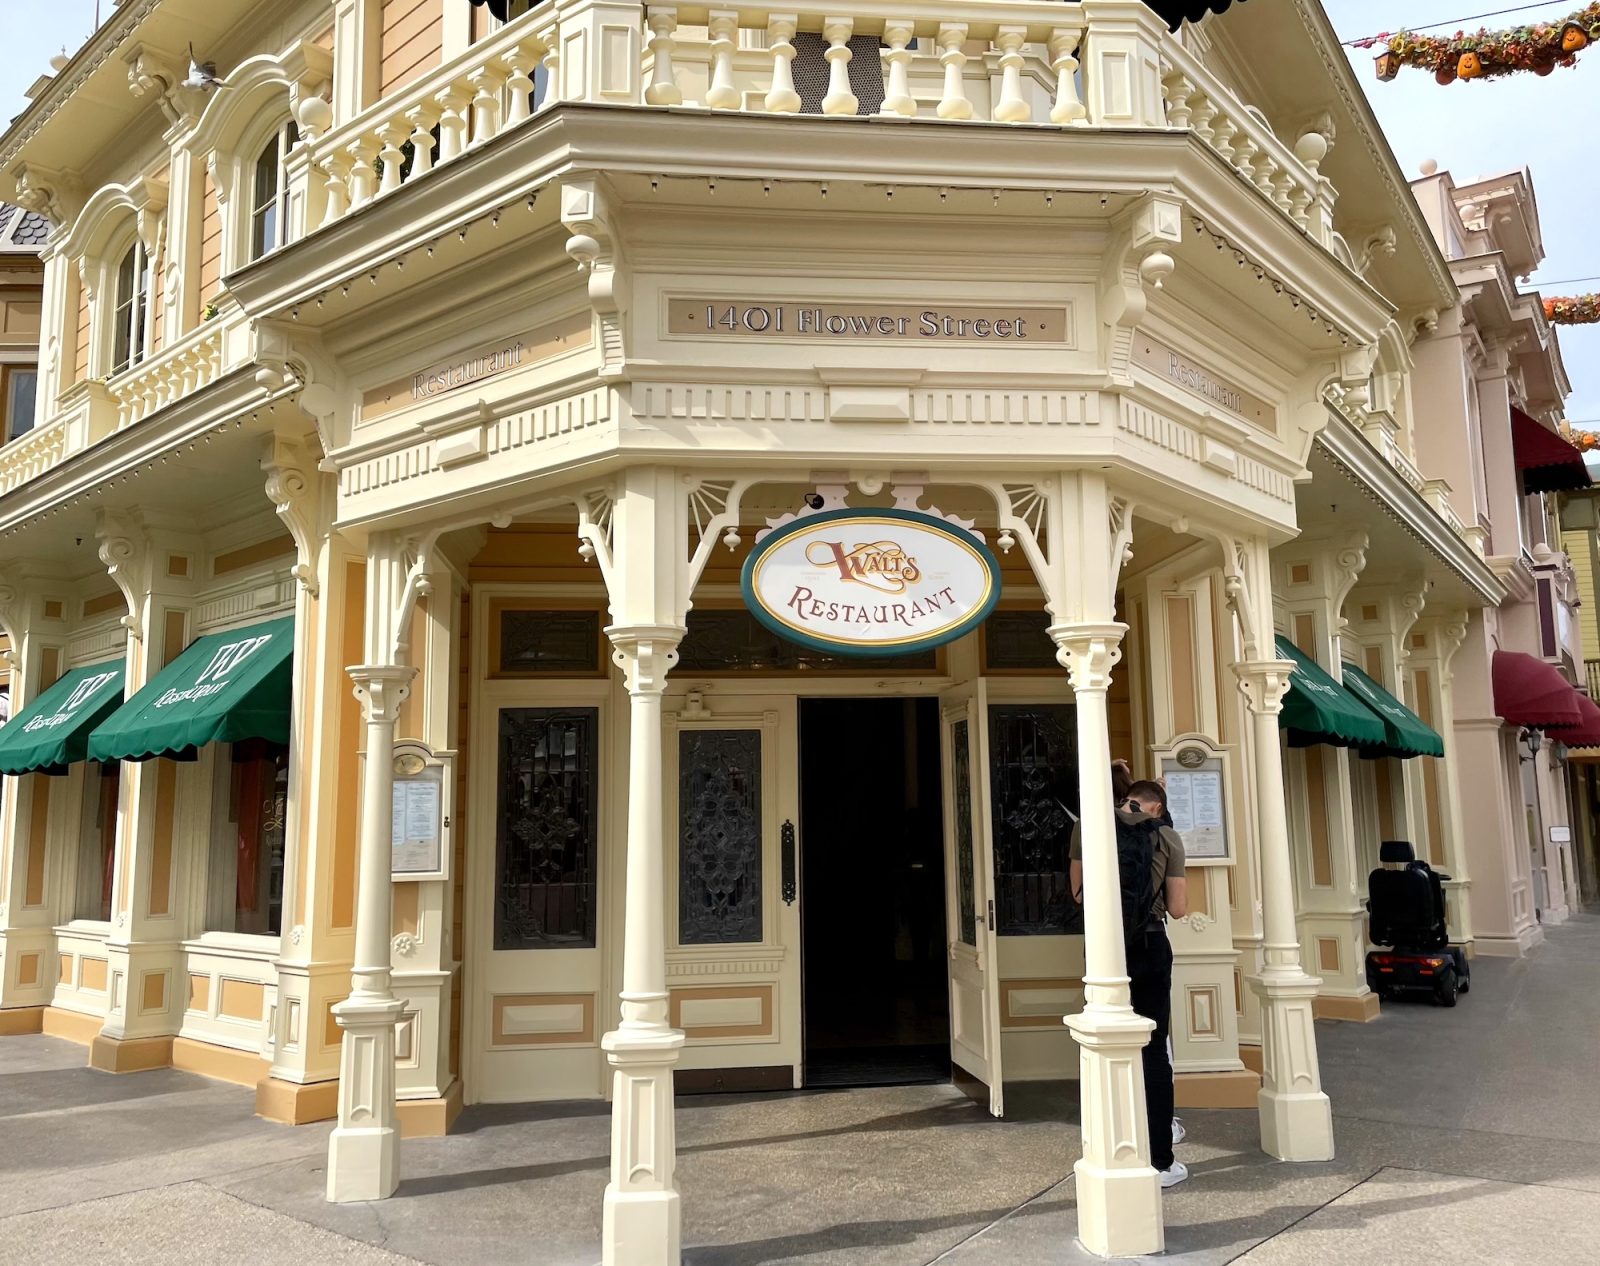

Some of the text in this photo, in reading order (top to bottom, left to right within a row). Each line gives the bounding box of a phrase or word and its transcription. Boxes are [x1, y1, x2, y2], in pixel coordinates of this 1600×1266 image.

[706, 305, 1027, 338] 1401 Flower Street
[412, 341, 523, 400] Restaurant
[1168, 351, 1242, 413] Restaurant
[787, 585, 956, 627] RESTAURANT
